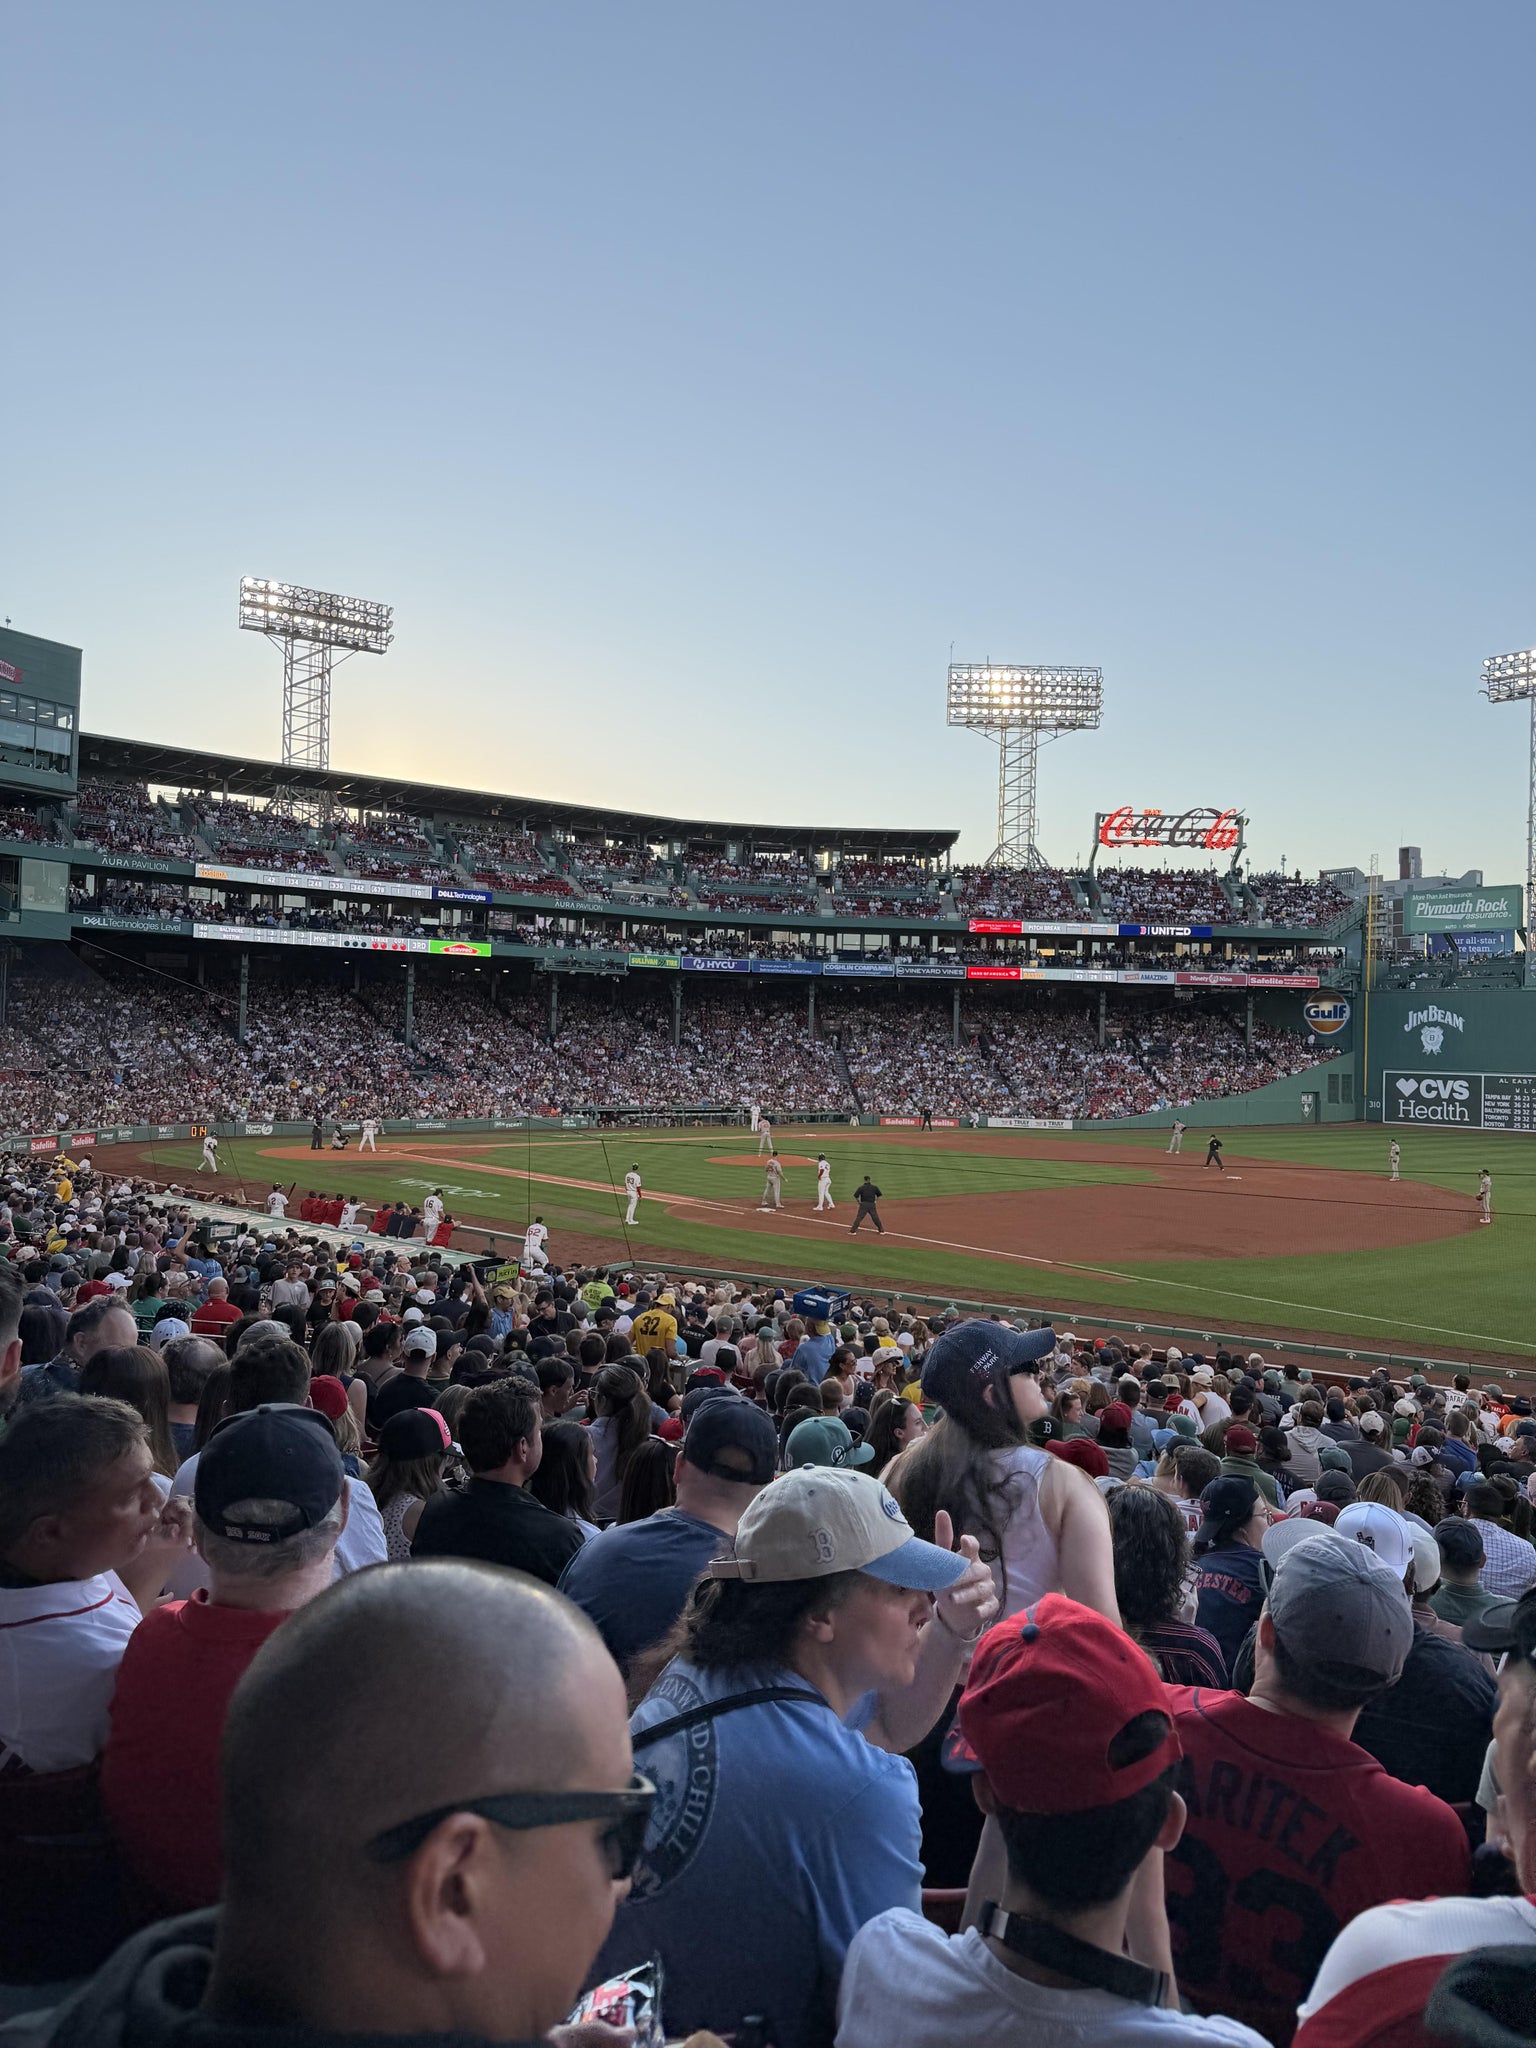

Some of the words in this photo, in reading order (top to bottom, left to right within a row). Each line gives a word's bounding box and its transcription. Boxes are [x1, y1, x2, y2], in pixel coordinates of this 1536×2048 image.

[1099, 806, 1241, 849] Coca-Cola
[131, 860, 169, 871] PAVILION
[576, 903, 603, 911] PAVILION
[1415, 900, 1473, 916] Plymouth
[1475, 898, 1508, 912] Rock
[161, 923, 181, 931] Level
[1151, 926, 1191, 936] UNITED
[1465, 936, 1497, 945] all-star
[631, 957, 657, 966] SULLIVAN
[666, 958, 678, 967] TIRE
[706, 959, 736, 969] HYCU
[1250, 977, 1284, 985] Safelite
[1305, 1004, 1347, 1019] Gulf
[1404, 1009, 1428, 1033] JIM
[1428, 1005, 1465, 1033] BEAM
[1419, 1078, 1470, 1100] CVS
[1368, 1101, 1381, 1109] 310
[1398, 1099, 1470, 1121] Health
[199, 1126, 207, 1136] 14
[30, 1141, 57, 1151] Safelite
[71, 1136, 95, 1147] Safelite
[271, 1197, 277, 1205] 2
[425, 1199, 435, 1209] 16
[639, 1315, 661, 1336] 32
[969, 1348, 995, 1374] FENWAY
[982, 1355, 1000, 1372] PARK
[1043, 1421, 1053, 1434] B
[807, 1527, 837, 1565] B
[1169, 1754, 1363, 1891] ARITEK
